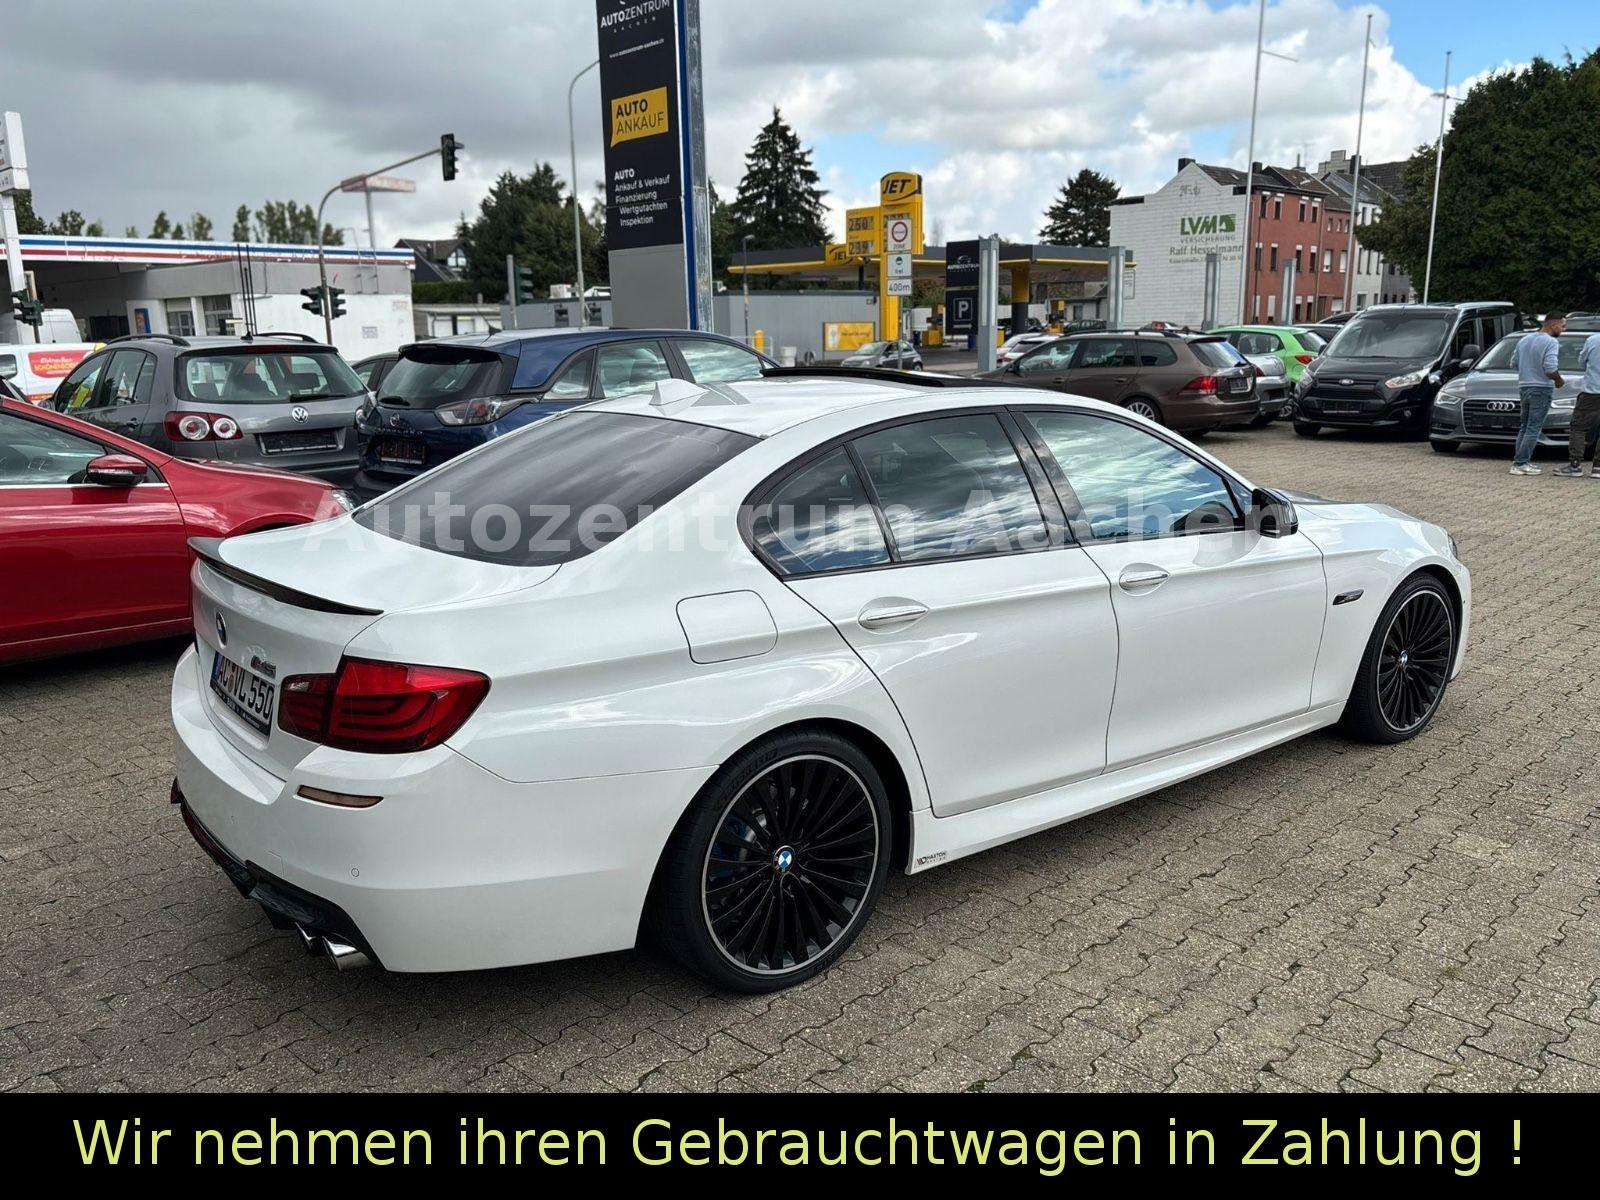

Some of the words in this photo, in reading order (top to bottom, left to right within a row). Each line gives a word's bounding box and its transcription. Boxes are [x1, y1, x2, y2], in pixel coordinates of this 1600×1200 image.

[600, 0, 670, 28] AUTOZENTRUM
[616, 98, 648, 119] AUTO
[616, 111, 664, 136] ANKAUF
[614, 168, 635, 180] AUTO
[615, 180, 637, 192] Ankauf
[639, 180, 643, 188] &
[644, 174, 671, 187] Verkauf
[883, 179, 911, 194] JET
[615, 191, 657, 204] Finanzierung
[619, 202, 668, 214] Wertgutachten
[619, 216, 654, 227] Inspektion
[1180, 215, 1217, 235] LVM
[1169, 246, 1187, 256] Ralf
[1190, 245, 1244, 255] Hesselmann
[888, 283, 911, 292] 400m
[247, 675, 276, 720] 550
